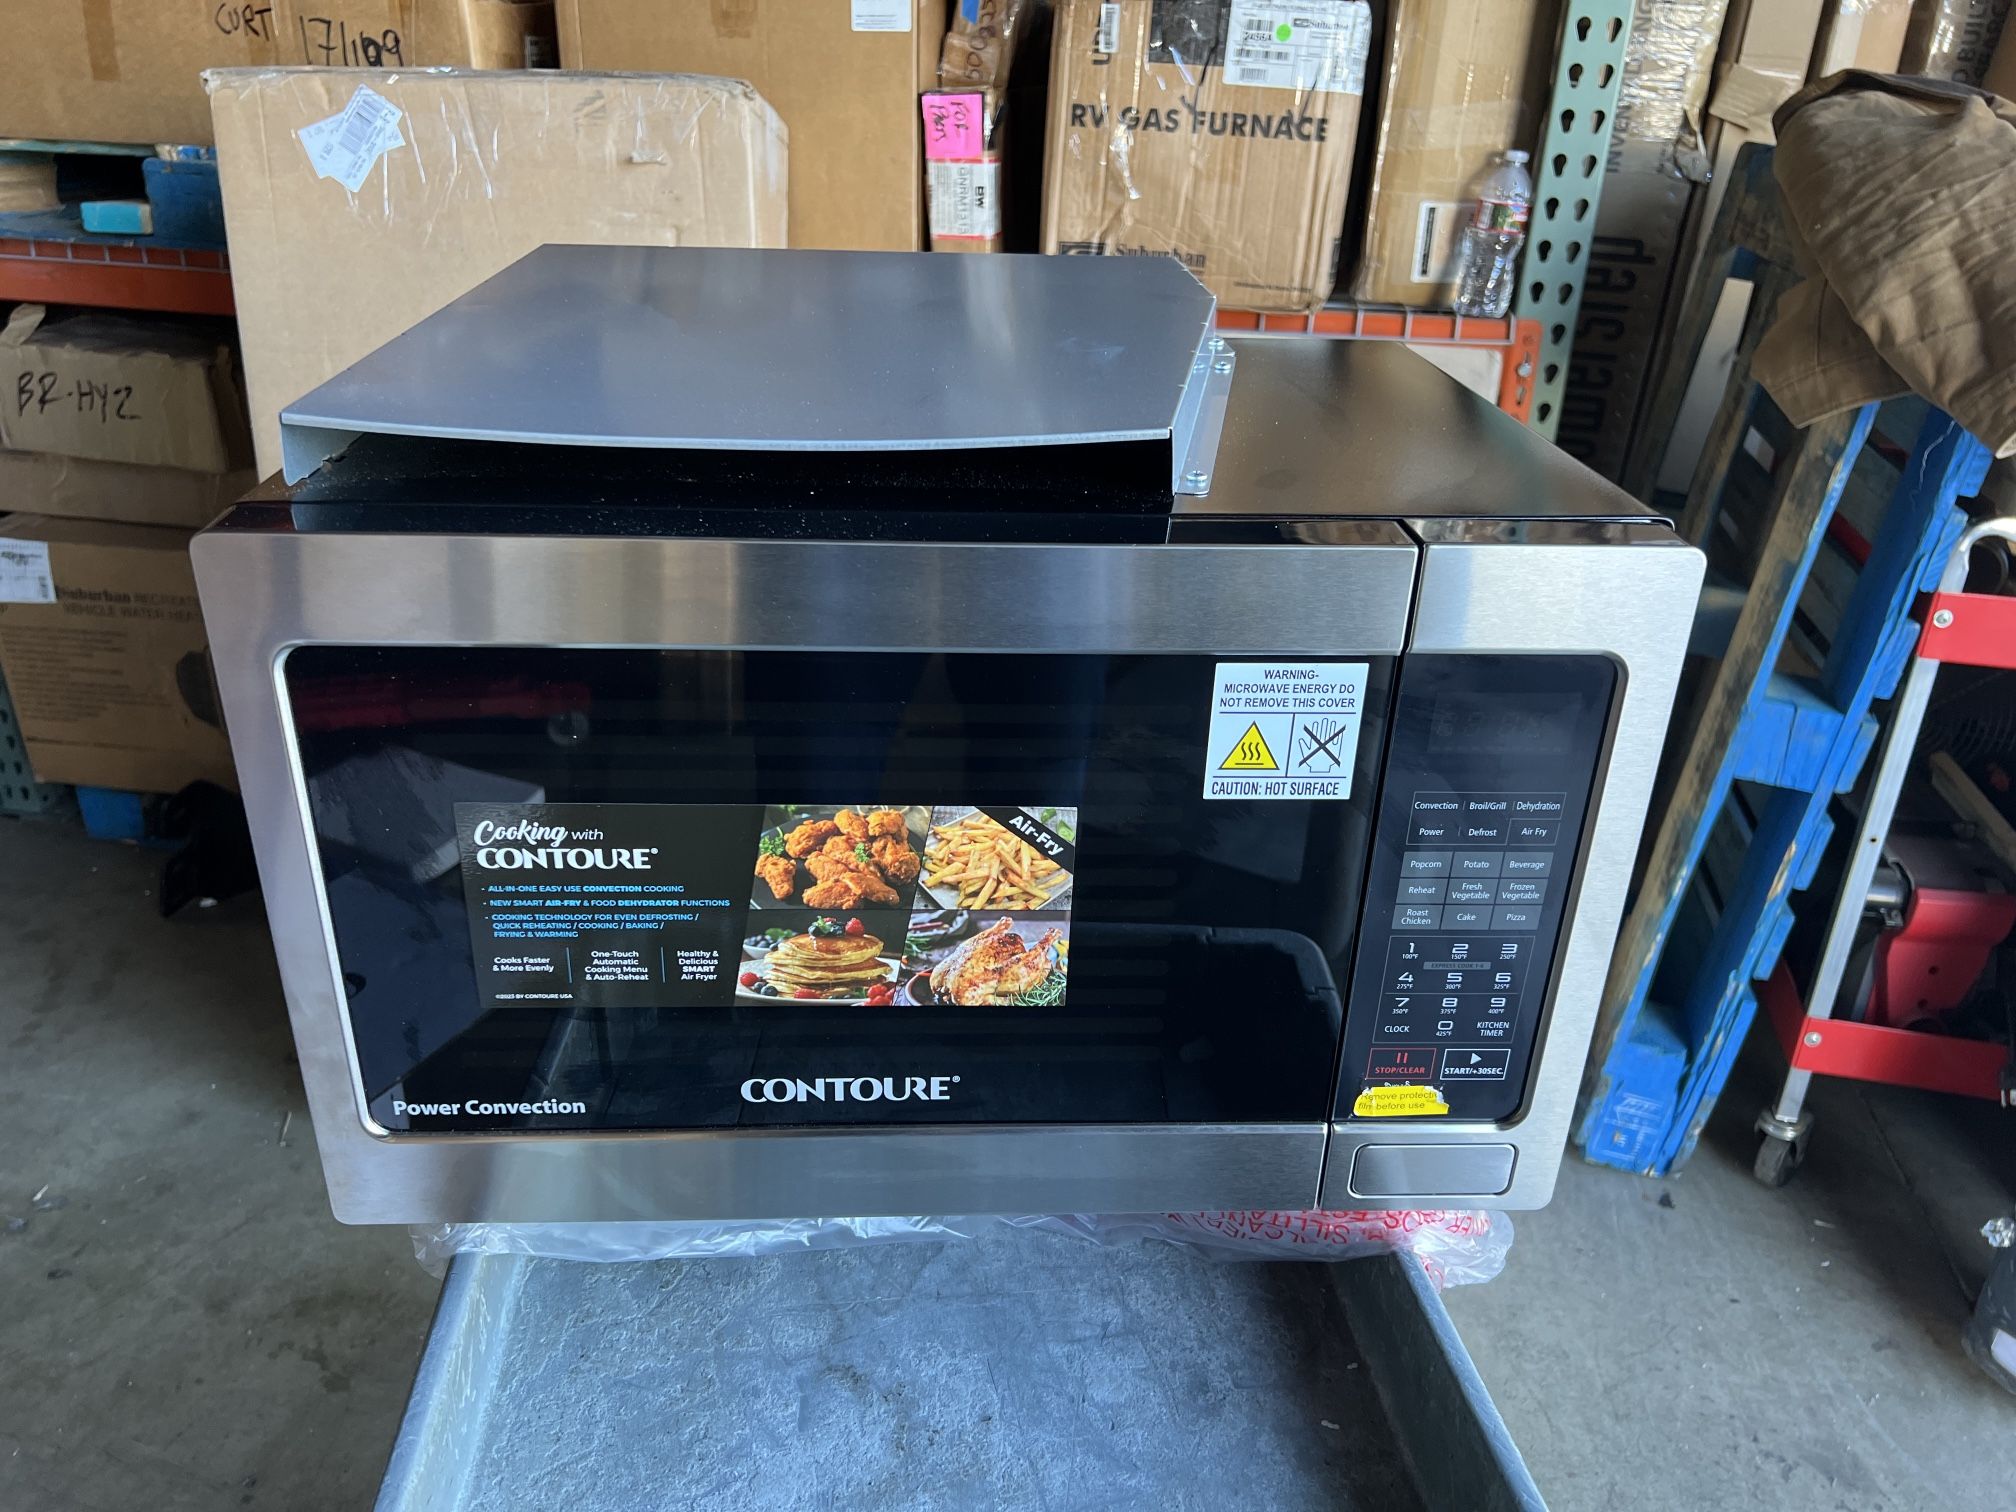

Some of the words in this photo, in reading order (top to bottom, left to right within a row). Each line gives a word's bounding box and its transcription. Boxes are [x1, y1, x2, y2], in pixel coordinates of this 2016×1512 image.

[215, 3, 271, 41] CURT
[1071, 104, 1108, 128] RV
[1118, 106, 1179, 133] GAS
[1191, 110, 1328, 142] FURNACE
[1264, 670, 1319, 680] WARNING-
[1224, 684, 1290, 693] MICROWAVE
[1293, 684, 1337, 693] ENERGY
[1339, 684, 1355, 693] DO
[1220, 698, 1242, 707] NOT
[1244, 698, 1289, 707] REMOVE
[1293, 698, 1315, 707] THIS
[1319, 698, 1355, 708] COVER
[1212, 782, 1262, 795] CAUTION:
[1265, 782, 1287, 795] HOT
[1290, 782, 1339, 795] SURFACE
[1415, 802, 1458, 810] Convection
[1470, 802, 1507, 810] Broil/Grill
[1517, 802, 1560, 812] Dehydration
[473, 819, 569, 847] Cooking
[571, 829, 604, 840] with
[1008, 815, 1064, 855] Air-Fry
[1419, 828, 1444, 836] Power
[1469, 828, 1497, 836] Defrost
[1535, 828, 1547, 837] Fry
[1411, 861, 1442, 869] Popcorn
[1509, 861, 1544, 870] Beverage
[1452, 892, 1490, 900] Vegetable
[1502, 892, 1540, 900] Vegetable
[1409, 942, 1415, 953] 1
[1452, 944, 1468, 953] 2
[1501, 944, 1518, 953] 3
[525, 965, 554, 973] Evenly
[1398, 972, 1414, 982] 4
[1447, 973, 1463, 982] 5
[1495, 973, 1511, 982] 6
[1395, 998, 1410, 1007] 7
[1442, 998, 1458, 1007] 8
[1491, 998, 1506, 1007] 9
[393, 1100, 461, 1115] Power
[465, 1099, 586, 1115] Convection
[1376, 1102, 1405, 1110] before
